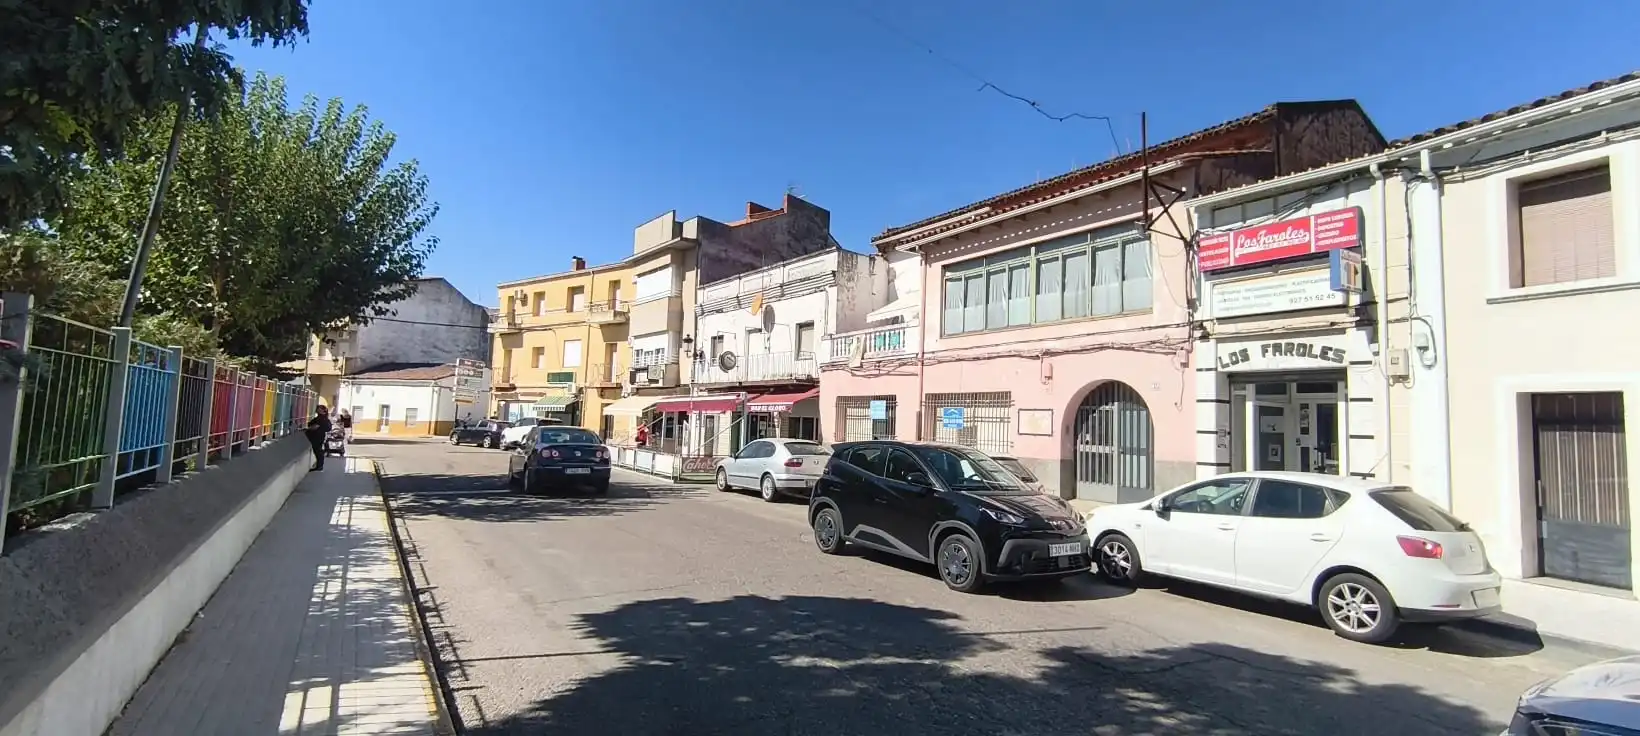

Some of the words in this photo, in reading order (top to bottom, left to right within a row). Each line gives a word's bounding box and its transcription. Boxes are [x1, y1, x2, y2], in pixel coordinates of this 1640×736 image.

[1236, 234, 1258, 250] Los
[1257, 225, 1306, 248] Faroles
[1289, 296, 1302, 304] 927
[1218, 347, 1250, 369] LOS
[1260, 342, 1347, 364] FAROLES
